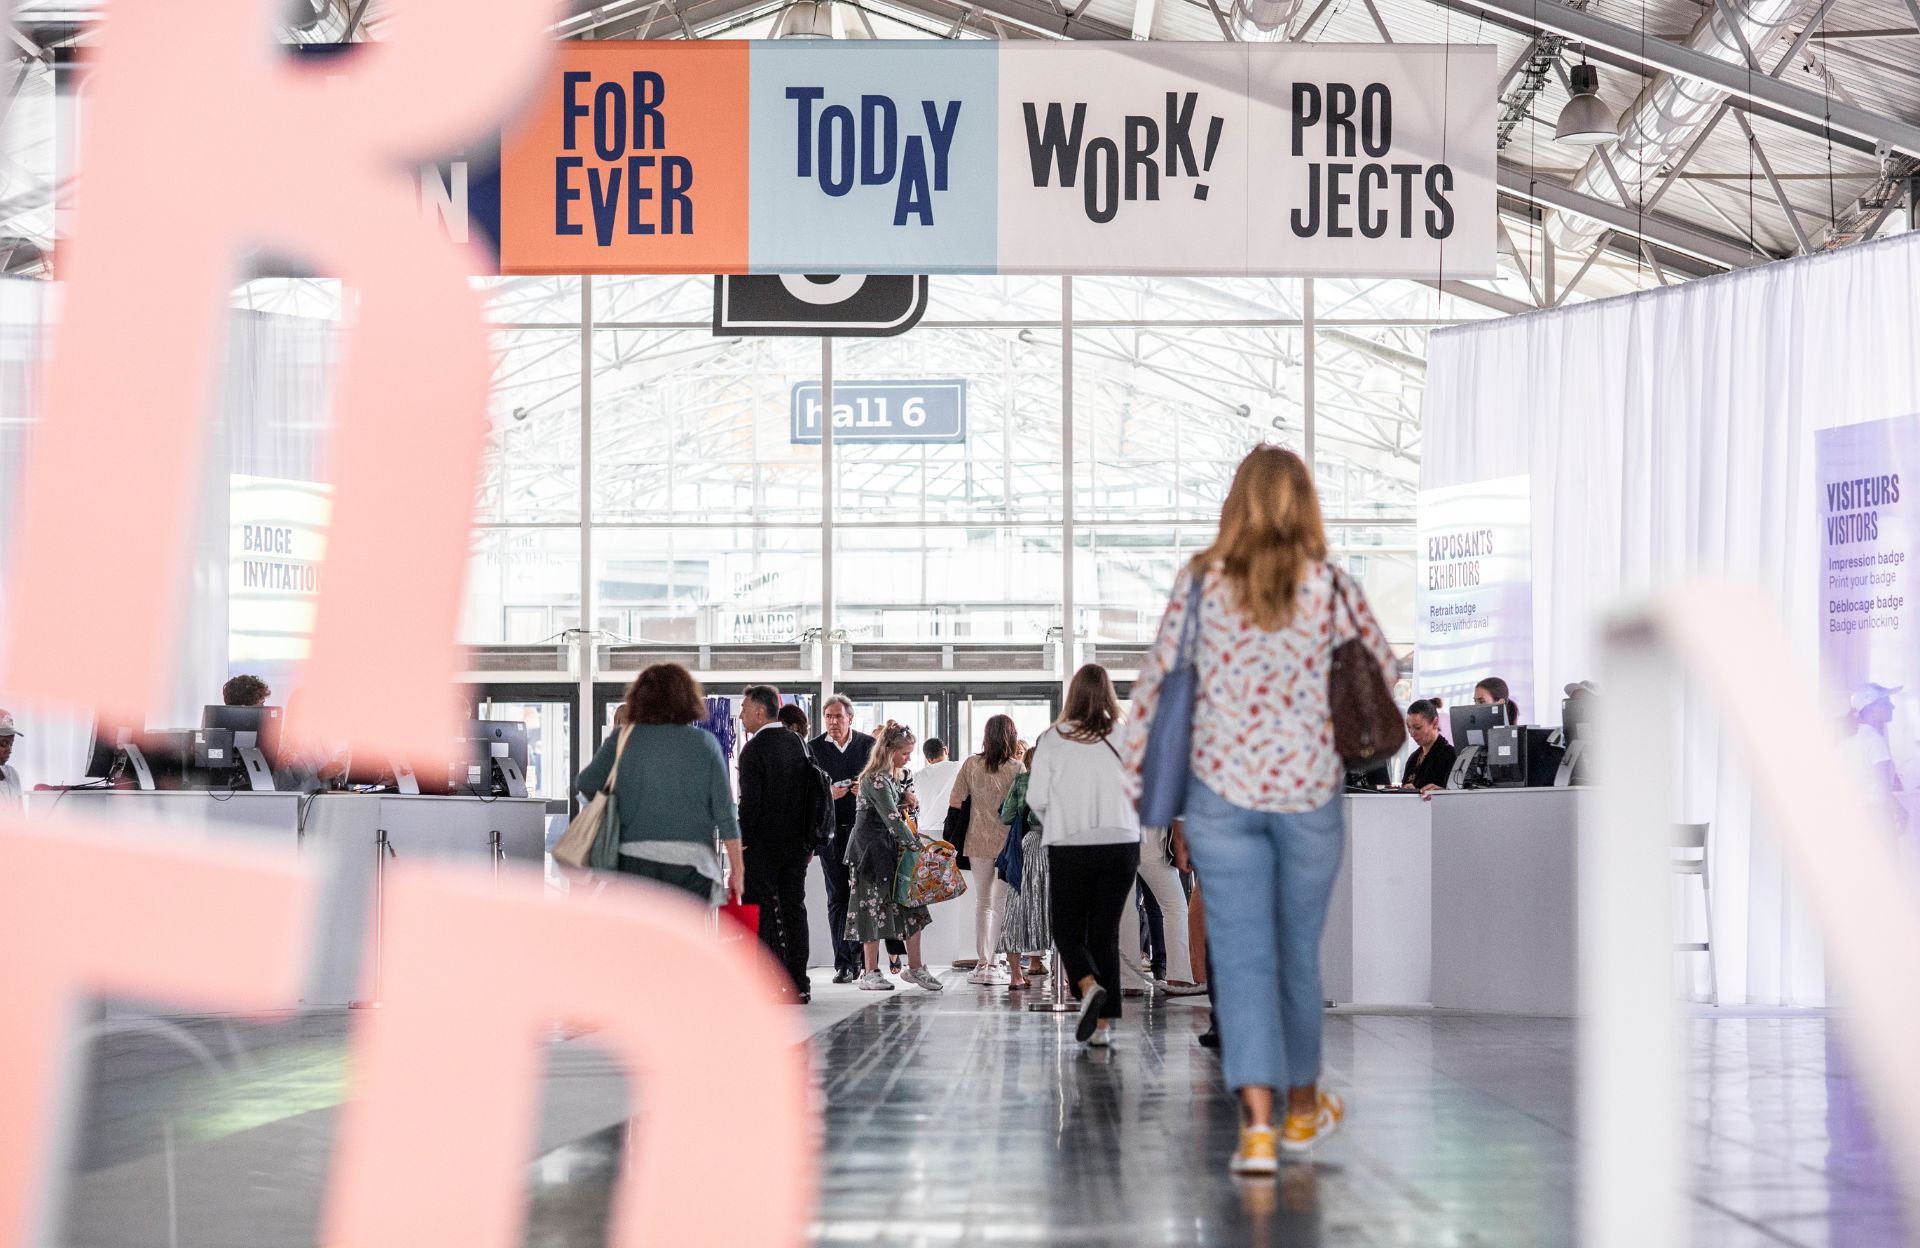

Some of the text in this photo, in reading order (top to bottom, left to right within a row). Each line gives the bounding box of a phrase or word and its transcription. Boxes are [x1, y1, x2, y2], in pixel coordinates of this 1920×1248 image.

[562, 70, 666, 162] FOR
[1290, 81, 1393, 159] PRO
[784, 86, 963, 227] TODAY
[1021, 90, 1225, 225] WORK!
[554, 154, 695, 248] EVER
[1289, 162, 1456, 240] JECTS
[806, 396, 927, 428] hall 6
[1826, 473, 1900, 513] VISITEURS
[243, 523, 292, 555] BADGE
[1826, 510, 1878, 546] VISITORS
[1428, 528, 1494, 562] EXPOSANTS
[1829, 550, 1905, 572] Impression badge
[1428, 560, 1480, 591] EXHIBITORS
[1829, 569, 1896, 591] Print your badge
[1430, 602, 1477, 618] Retrait badge
[1829, 594, 1904, 616] Déblocage badge
[1430, 616, 1489, 636] Badge withdrawal
[1829, 613, 1899, 635] Badge unlocking
